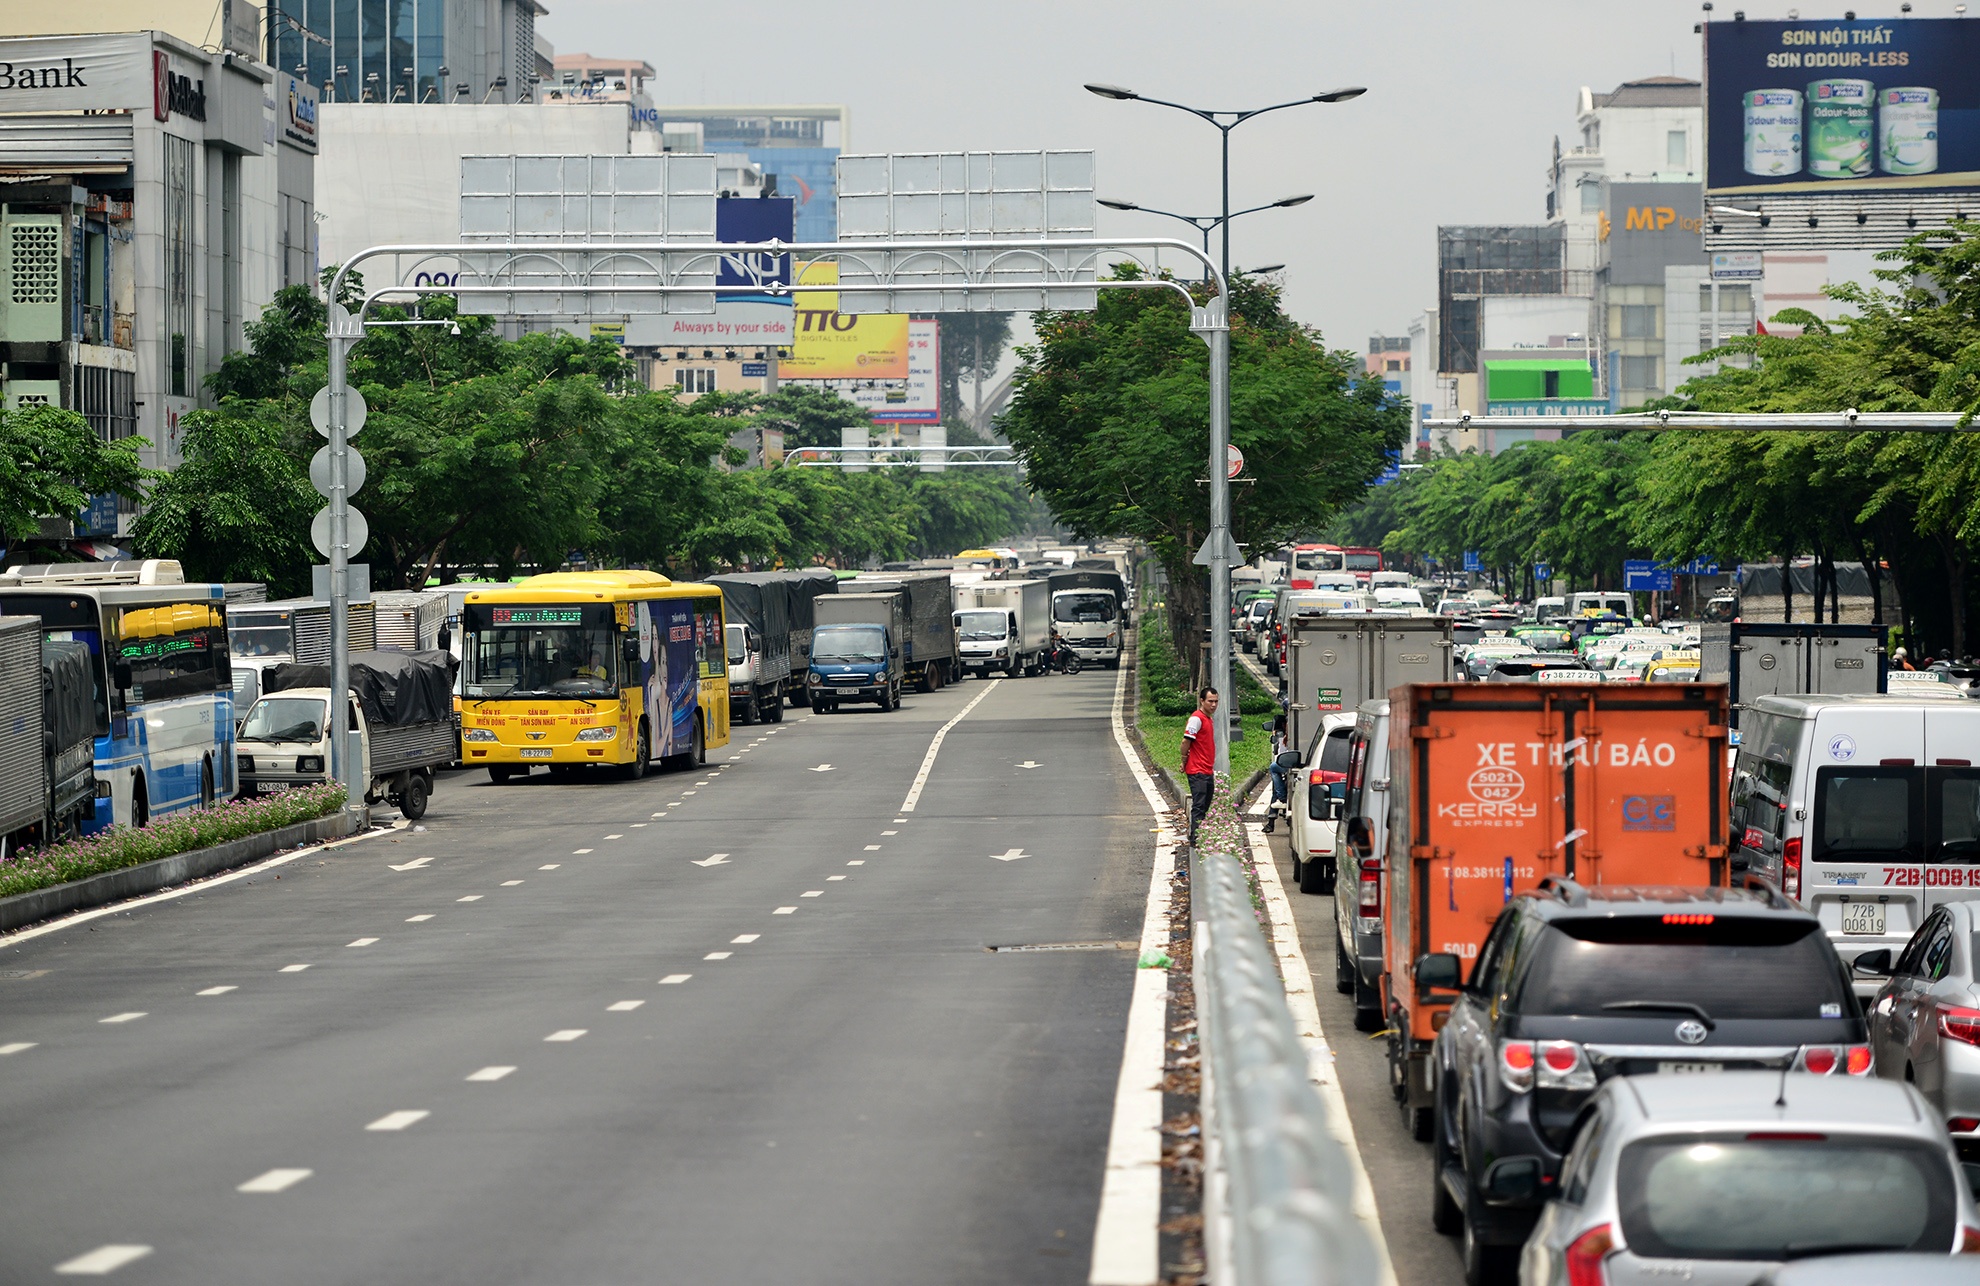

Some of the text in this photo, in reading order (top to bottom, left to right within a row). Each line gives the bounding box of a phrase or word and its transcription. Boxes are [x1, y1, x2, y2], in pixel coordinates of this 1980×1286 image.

[1782, 25, 1893, 48] SƠN NỘI THẤT
[1767, 51, 1909, 68] SƠN ODOUR-LESS
[0, 58, 87, 89] Bank
[1625, 206, 1676, 231] MP
[673, 321, 786, 335] Always by your side
[1567, 406, 1606, 416] MART
[1477, 743, 1516, 766] XE
[1610, 738, 1676, 766] BÁO
[1479, 773, 1513, 783] 5021
[1483, 788, 1510, 798] 042
[1438, 803, 1537, 818] KERRY
[1822, 872, 1867, 880] TRANSIT
[1853, 905, 1875, 918] 72B
[1844, 918, 1884, 932] 008.19
